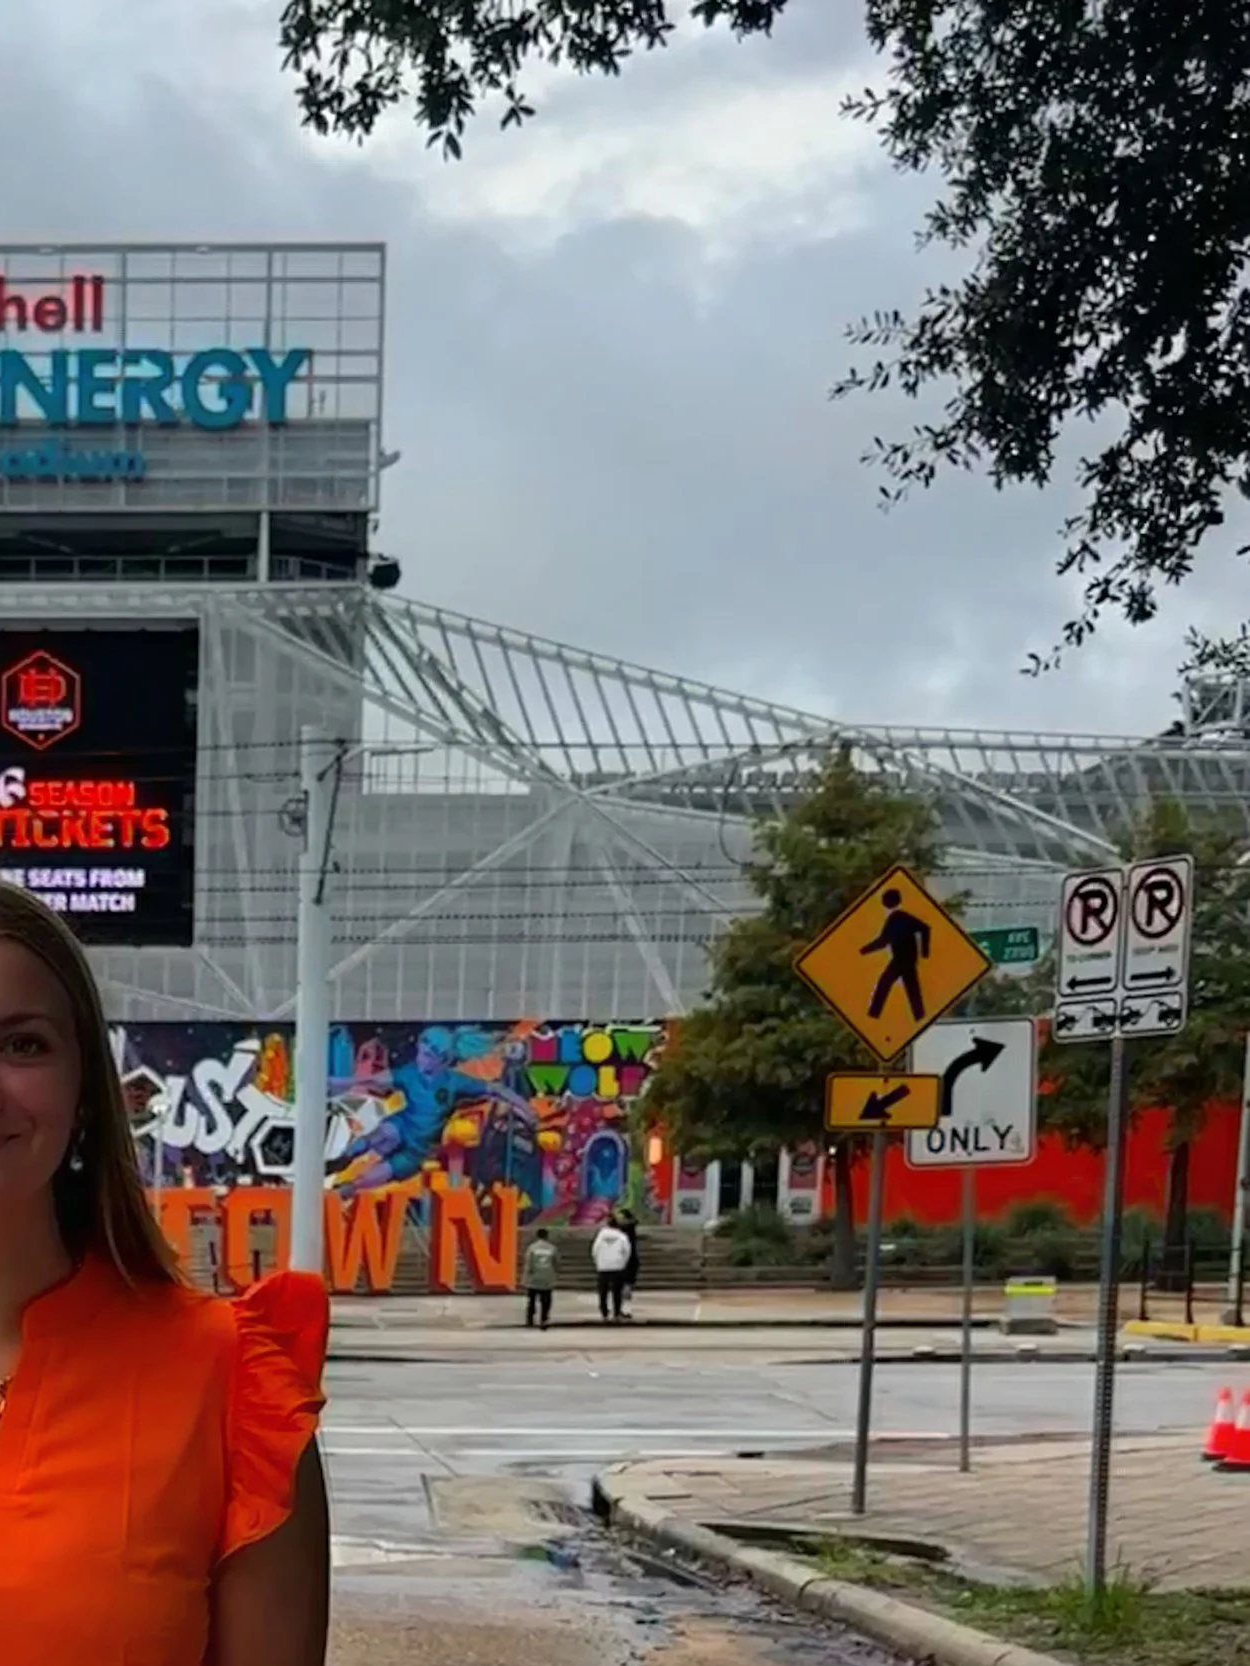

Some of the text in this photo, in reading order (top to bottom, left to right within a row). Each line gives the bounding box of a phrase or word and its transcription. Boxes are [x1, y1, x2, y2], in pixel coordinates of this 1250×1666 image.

[29, 781, 135, 806] SEASON
[27, 868, 87, 888] SEATS
[89, 868, 145, 888] FROM
[69, 892, 135, 912] MATCH
[528, 1030, 653, 1064] MEOW
[927, 1124, 1013, 1153] ONLY
